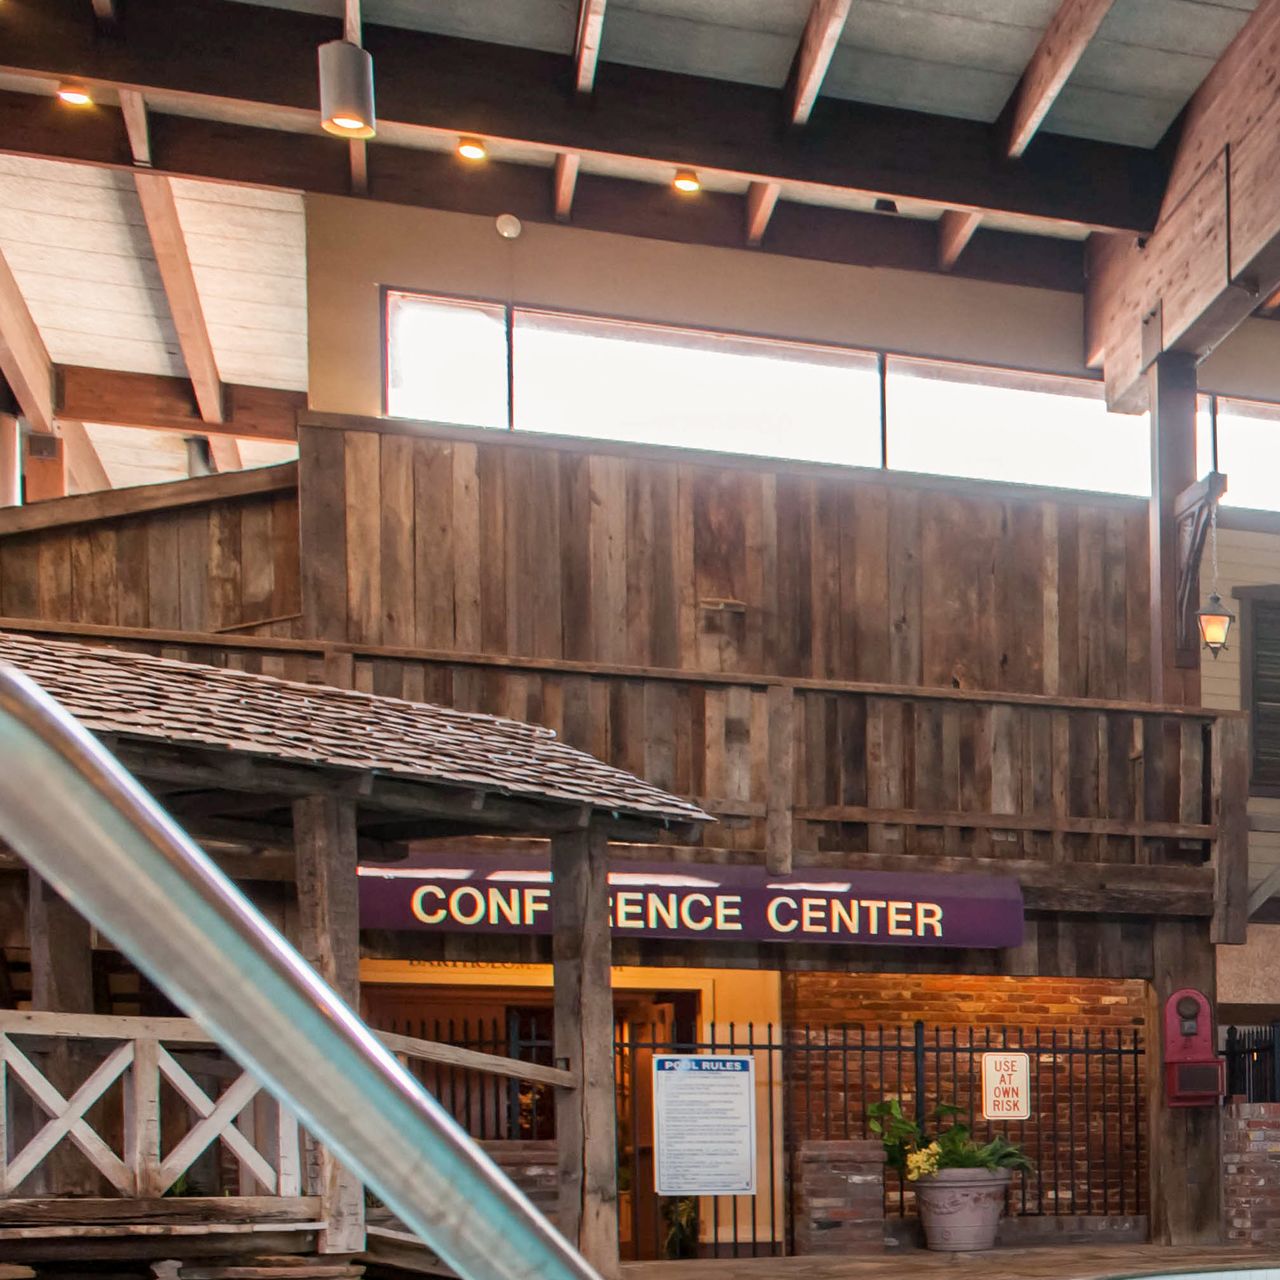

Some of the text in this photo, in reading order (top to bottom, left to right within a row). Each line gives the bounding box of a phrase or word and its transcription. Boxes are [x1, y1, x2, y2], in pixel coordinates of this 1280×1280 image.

[410, 884, 943, 937] CONFENCE CENTER
[702, 1061, 742, 1070] RULES
[995, 1060, 1018, 1072] USE
[999, 1073, 1013, 1085] AT
[993, 1086, 1019, 1098] OWN
[992, 1100, 1020, 1111] RISK
